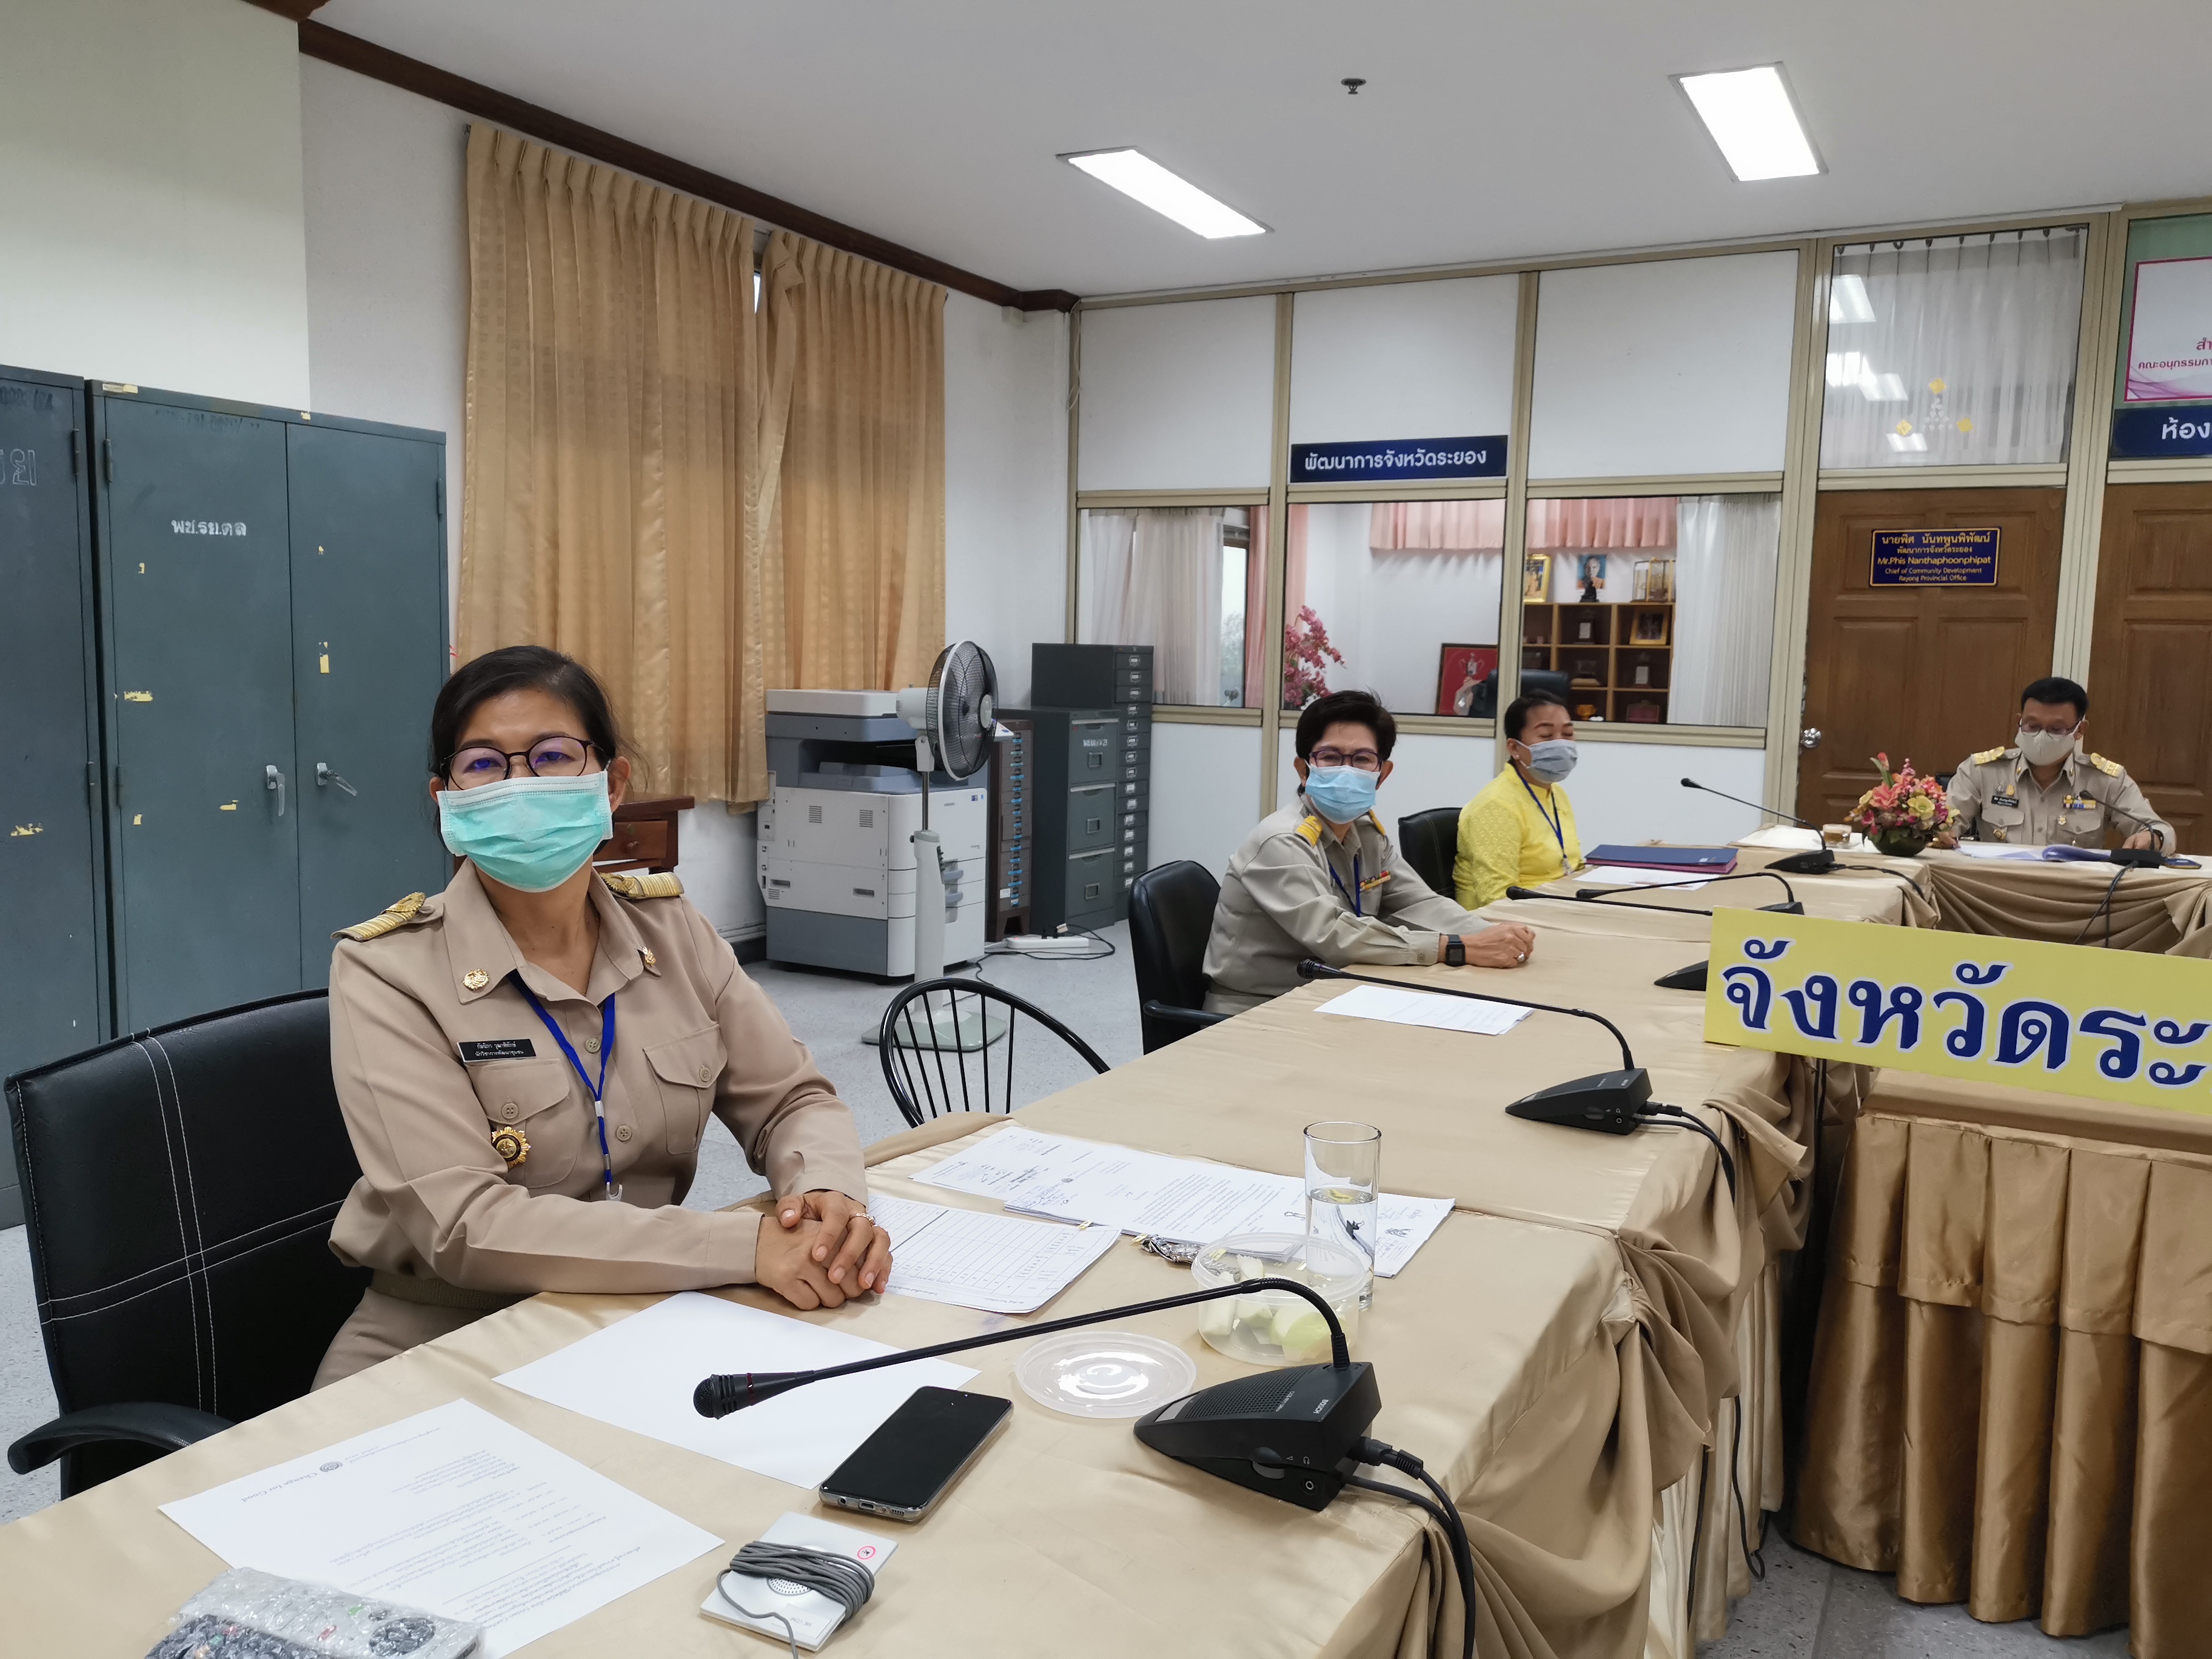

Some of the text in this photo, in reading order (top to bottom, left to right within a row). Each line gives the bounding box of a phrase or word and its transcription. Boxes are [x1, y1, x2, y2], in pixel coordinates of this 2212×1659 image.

[2162, 417, 2210, 440] ห้อง
[1305, 448, 1487, 471] พัฒนาการจังหวัดระยอง
[1882, 533, 1914, 544] นายพิศ
[1897, 545, 1972, 554] พัฒนาการจังหวัดระยอง
[1908, 556, 1991, 565] Nanthaphoonphipat
[1721, 937, 2211, 1086] จังหวัดระ
[1313, 1399, 1329, 1414] BOSCH
[284, 1472, 317, 1486] Change
[241, 1490, 267, 1502] Good
